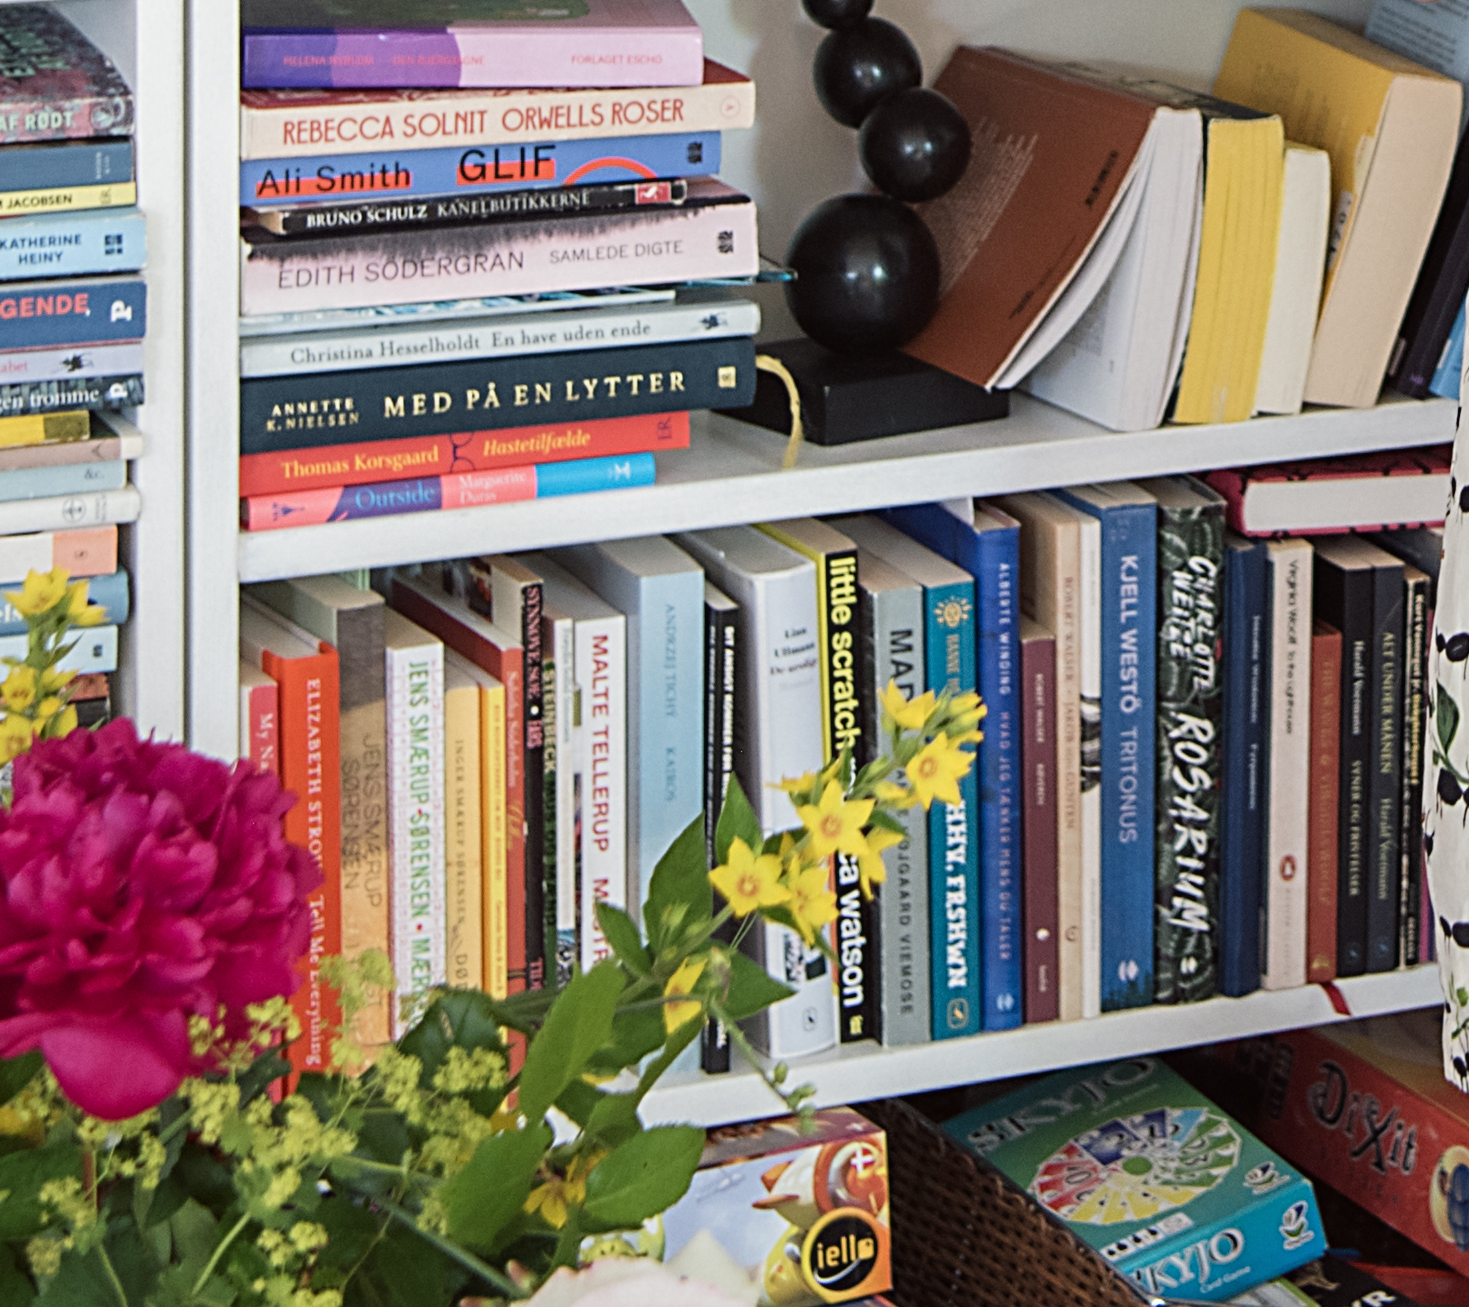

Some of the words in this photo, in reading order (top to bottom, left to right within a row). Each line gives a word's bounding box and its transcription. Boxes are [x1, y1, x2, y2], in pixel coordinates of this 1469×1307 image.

[283, 118, 395, 145] REBECCA
[404, 112, 488, 137] SOLNIT
[502, 105, 604, 131] ORWELLS
[611, 98, 684, 124] ROSER
[257, 168, 303, 197] Ali
[315, 160, 411, 191] Smith
[459, 145, 556, 182] GLIF
[18, 248, 63, 265] HEINY
[278, 264, 356, 290] EDITH
[364, 251, 524, 282] SÖDERGRAN
[549, 244, 627, 264] SAMLEDE
[634, 240, 684, 256] DIGTE
[384, 391, 451, 419] MED
[466, 382, 501, 411] PÅ
[515, 383, 552, 406] EN
[566, 371, 685, 400] LYTTER
[281, 455, 350, 480] Thomas
[355, 445, 439, 473] Korsgaard
[482, 431, 591, 457] Hastetilfælde
[827, 556, 855, 631] little
[1120, 554, 1137, 619] KJELL
[593, 634, 609, 714] MALTE
[831, 638, 861, 748] scratch
[1120, 627, 1140, 713] WESTÖ
[593, 723, 609, 853] TELLERUP
[1120, 728, 1138, 845] TRITONUS
[1171, 713, 1211, 930] ROSARIUM
[838, 901, 864, 1010] watson
